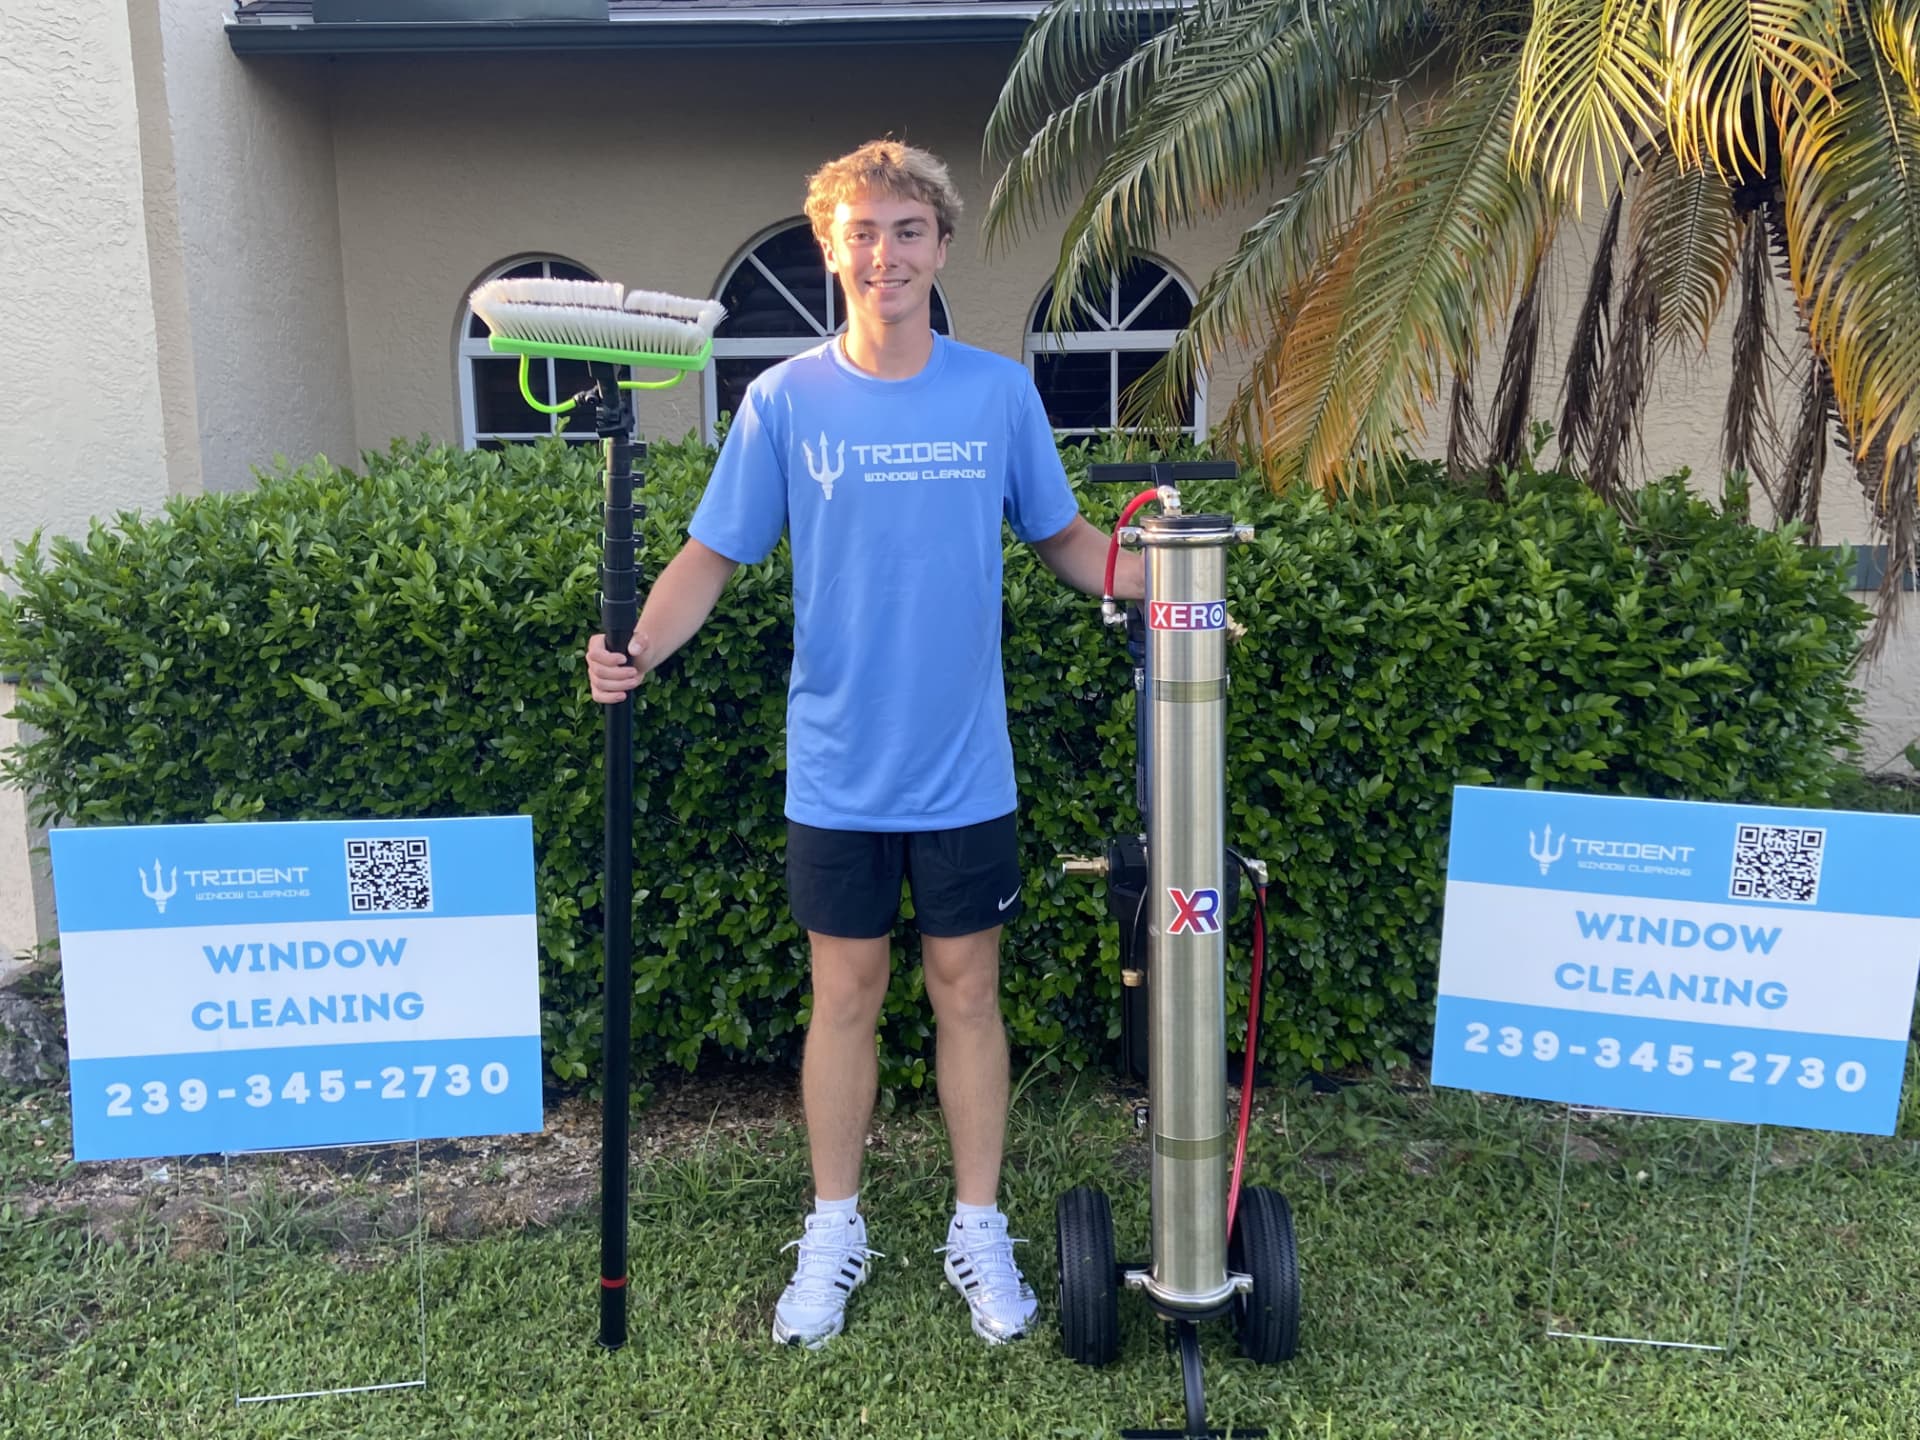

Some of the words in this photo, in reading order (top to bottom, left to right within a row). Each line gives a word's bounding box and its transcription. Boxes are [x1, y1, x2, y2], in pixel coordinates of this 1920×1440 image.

[851, 441, 988, 465] TRIDENT
[864, 471, 918, 482] WINDOW
[922, 469, 986, 480] CLEANING
[1152, 603, 1225, 629] XERO
[1570, 838, 1696, 863] TRIDENT
[184, 866, 310, 887] TRIDENT
[1627, 865, 1692, 877] CLEANING
[247, 889, 311, 900] CLEANING
[1166, 887, 1221, 935] XR
[1575, 910, 1783, 955] WINDOW
[202, 937, 408, 974] WINDOW
[1553, 962, 1789, 1010] CLEANING
[191, 991, 425, 1031] CLEANING
[1464, 1022, 1867, 1093] 239-345-2730
[105, 1062, 510, 1117] 239-345-2730
